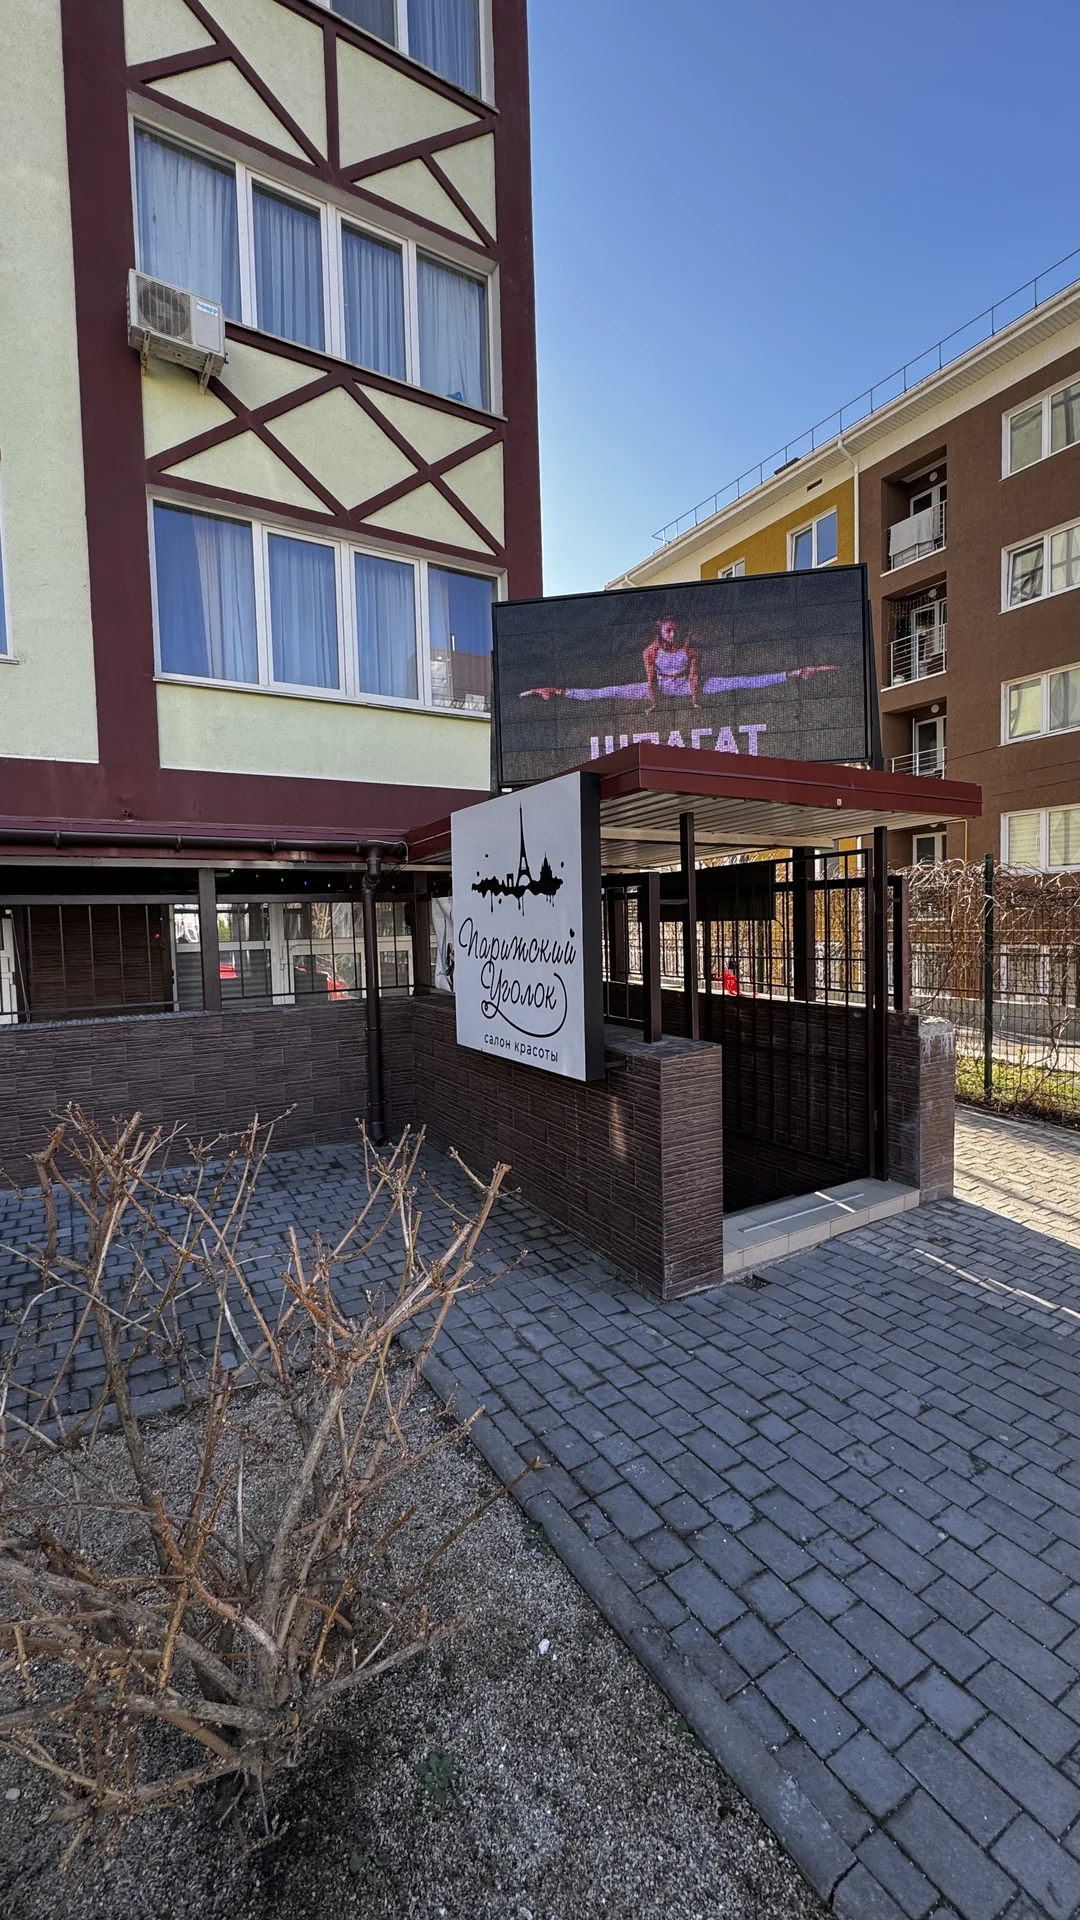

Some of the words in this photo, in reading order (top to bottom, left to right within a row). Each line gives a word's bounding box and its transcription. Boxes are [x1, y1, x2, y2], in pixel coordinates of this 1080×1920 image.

[458, 917, 577, 973] Парижский
[480, 960, 562, 1021] Уголок
[484, 1033, 511, 1050] салон
[514, 1041, 559, 1062] красоты
